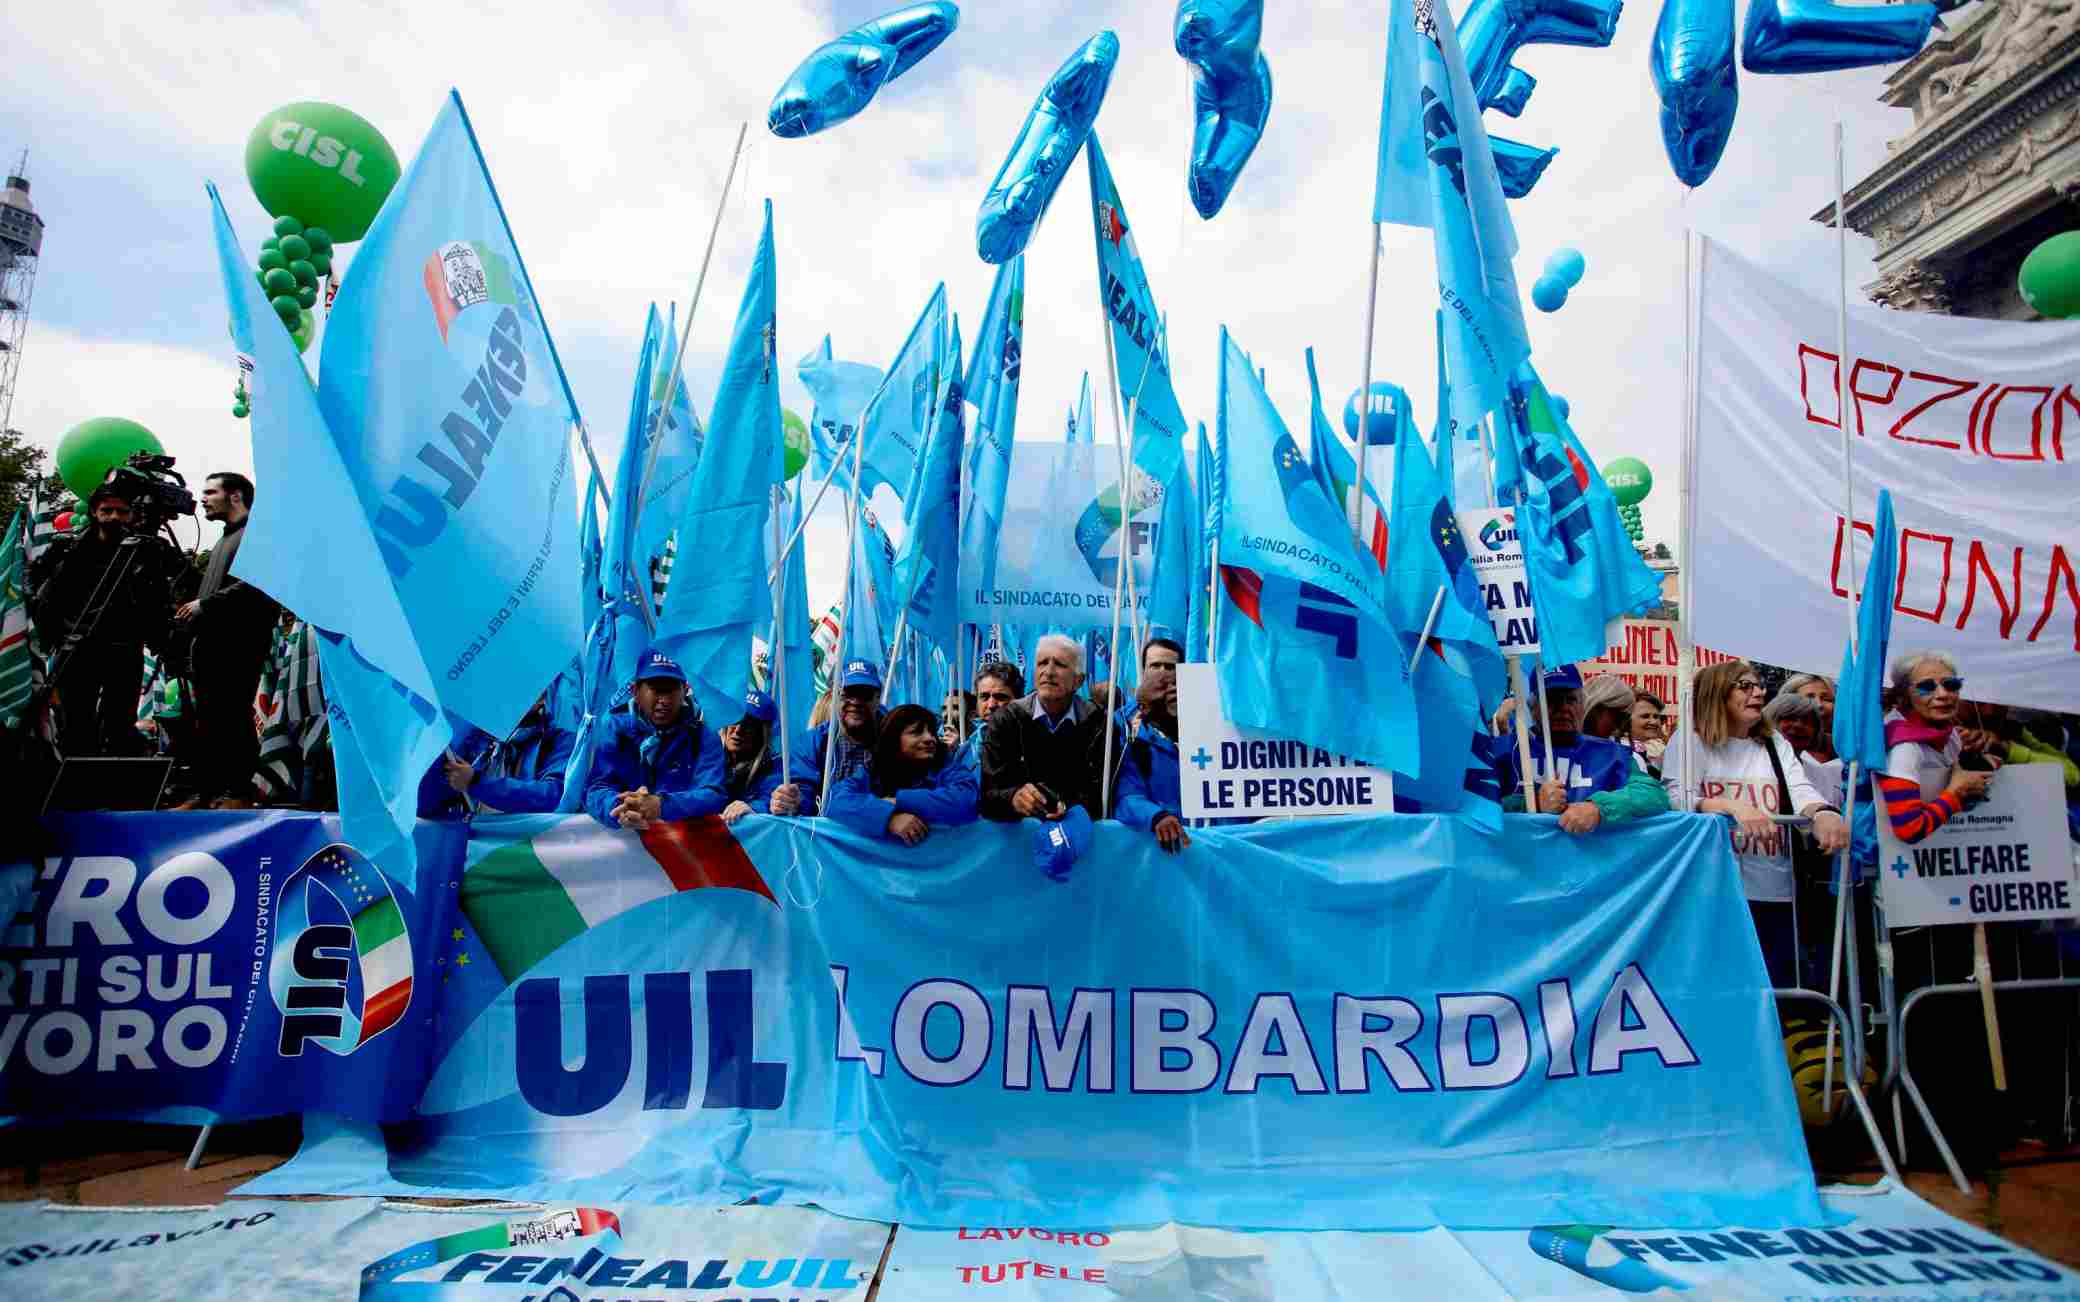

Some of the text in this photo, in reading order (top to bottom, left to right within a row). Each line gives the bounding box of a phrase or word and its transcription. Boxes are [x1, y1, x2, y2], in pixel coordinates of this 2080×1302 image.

[269, 119, 367, 187] CISL
[1253, 535, 1342, 574] SINDACATO
[1496, 553, 1522, 564] Rom
[975, 589, 988, 605] IL
[992, 590, 1083, 608] SINDACATO
[1202, 776, 1373, 809] LE PERSONE
[1967, 814, 2015, 827] Romagna
[258, 856, 273, 871] IL
[1912, 843, 2031, 878] WELFARE
[1968, 880, 2071, 914] GUERRE
[253, 872, 273, 958] SINDACATO
[98, 953, 233, 1005] SUL
[250, 960, 264, 986] DEI
[514, 968, 788, 1117] UIL
[829, 962, 1702, 1097] LOMBARDIA
[957, 1226, 1111, 1248] LAVORO
[1604, 1226, 2020, 1266] FENEALUIL
[441, 1246, 861, 1291] FENEALUIL
[955, 1260, 1109, 1284] TUTELE
[1787, 1257, 2064, 1287] MILANO
